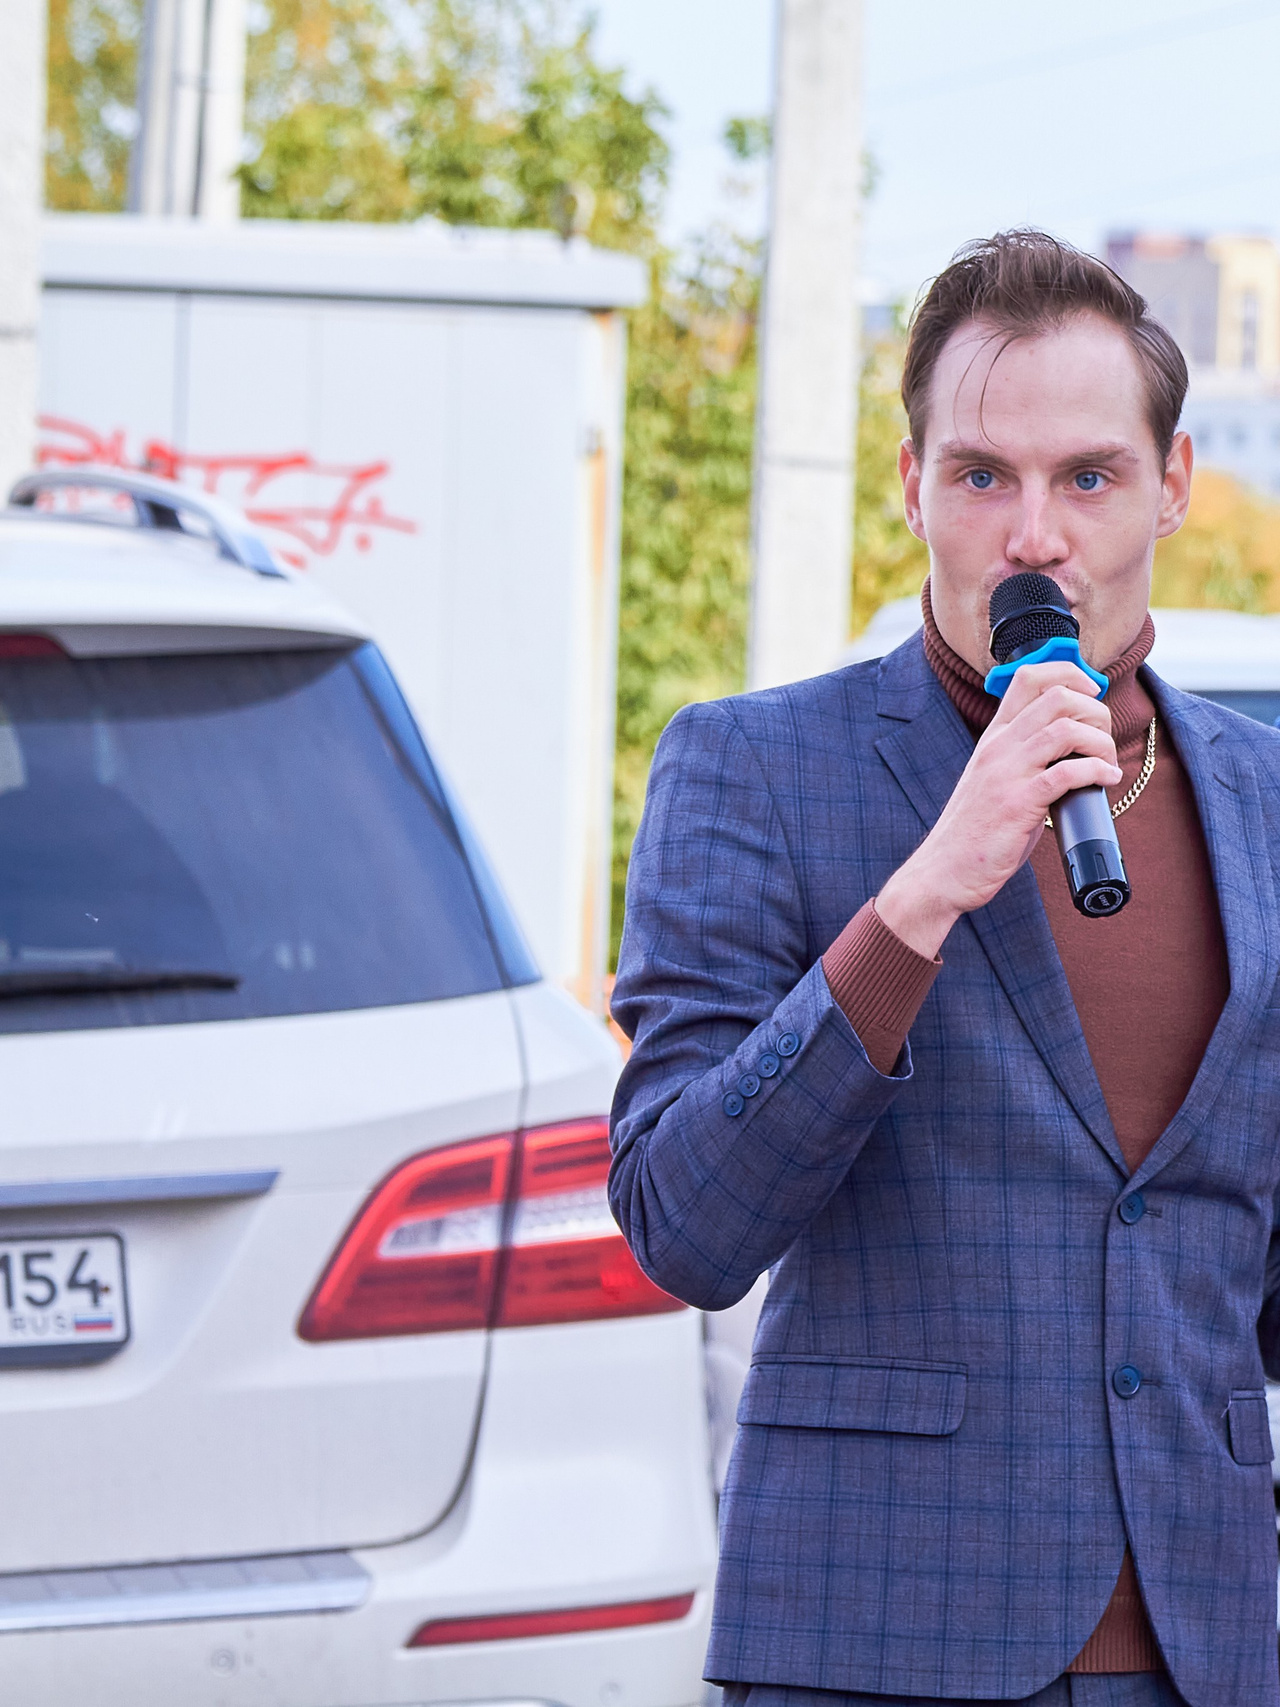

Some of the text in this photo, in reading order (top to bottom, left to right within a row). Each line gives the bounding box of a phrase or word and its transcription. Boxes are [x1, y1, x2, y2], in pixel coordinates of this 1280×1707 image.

[1098, 894, 1110, 906] UHF
[0, 1249, 102, 1310] 154
[11, 1315, 66, 1334] RUS
